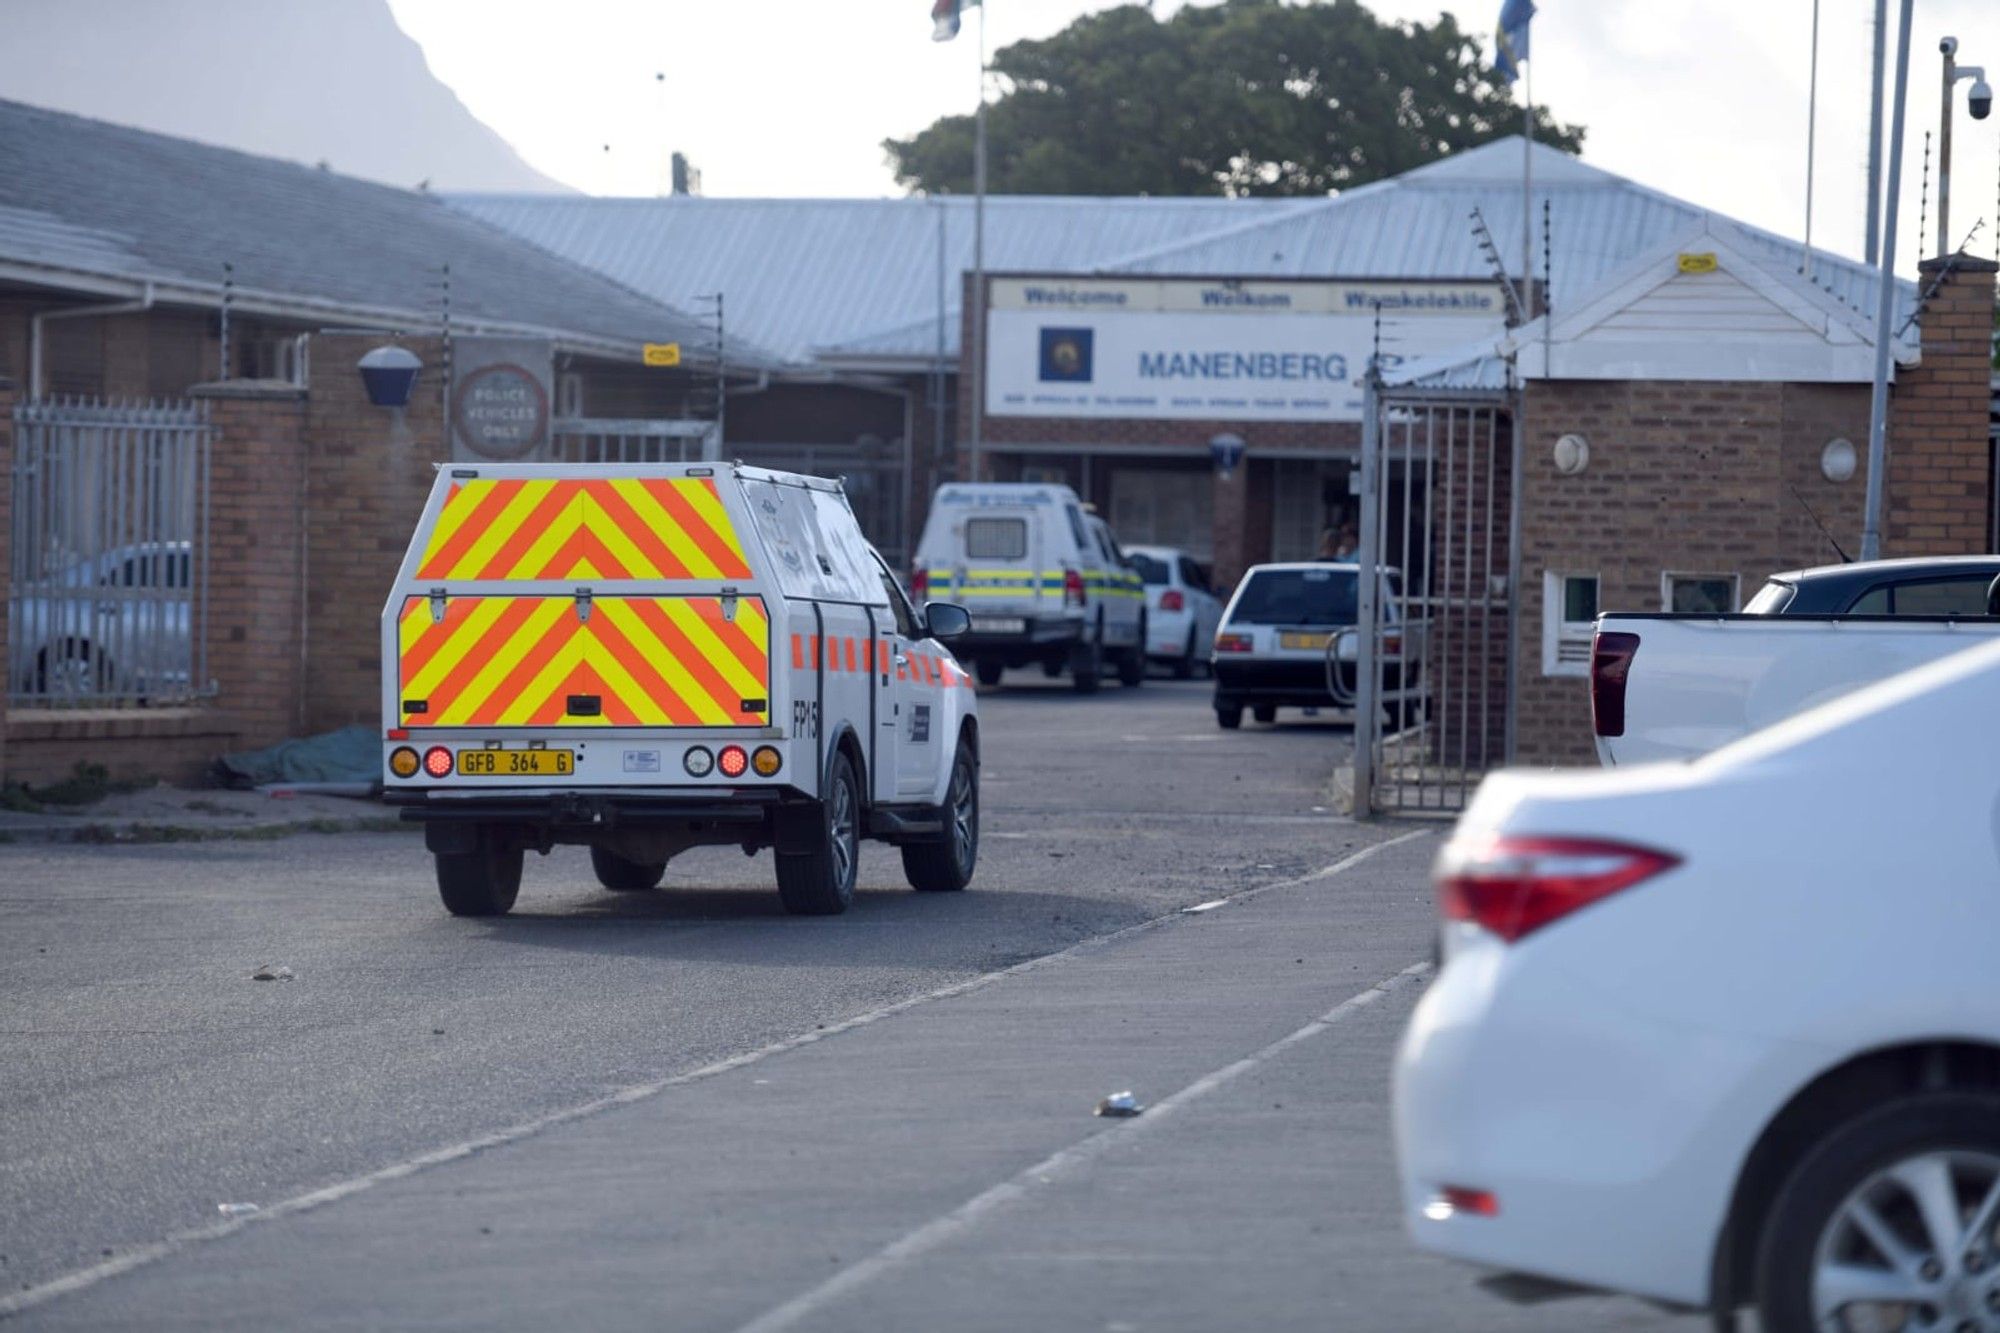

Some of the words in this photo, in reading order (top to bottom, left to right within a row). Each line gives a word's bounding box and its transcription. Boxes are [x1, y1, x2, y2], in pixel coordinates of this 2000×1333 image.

[1023, 286, 1128, 305] Welcome
[1201, 288, 1291, 306] Welkom
[1139, 351, 1348, 381] MANENBERG
[474, 388, 526, 401] POLICE
[467, 407, 536, 419] VEHICLES
[482, 425, 520, 438] ONLY
[465, 753, 496, 772] GFB
[510, 753, 539, 772] 364
[557, 753, 567, 772] G
